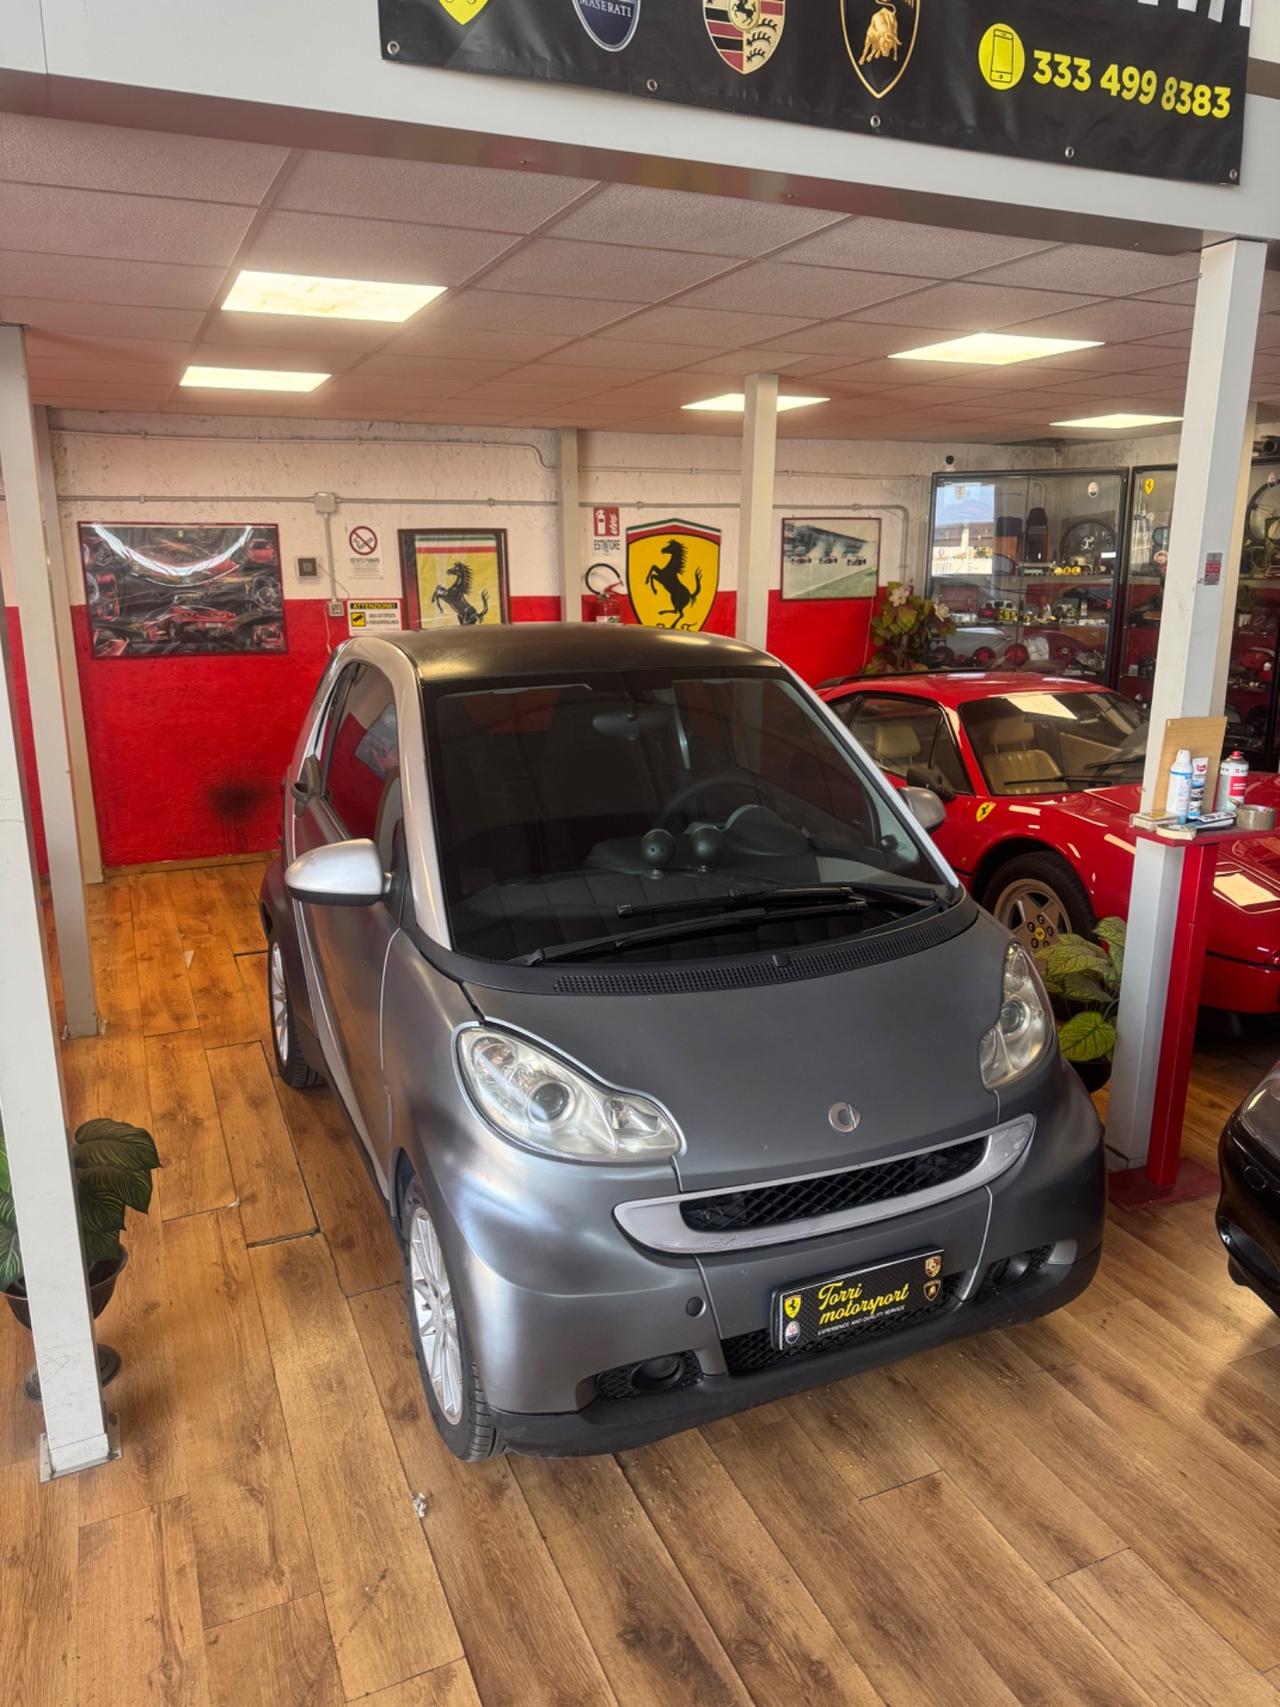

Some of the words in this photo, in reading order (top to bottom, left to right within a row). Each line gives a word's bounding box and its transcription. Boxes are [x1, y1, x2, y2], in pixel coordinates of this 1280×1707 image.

[579, 0, 631, 17] MASERATI
[1033, 50, 1092, 92] 333
[1100, 64, 1157, 105] 499
[1161, 76, 1232, 119] 8383
[817, 1280, 863, 1310] Torri
[819, 1283, 910, 1325] motorsport
